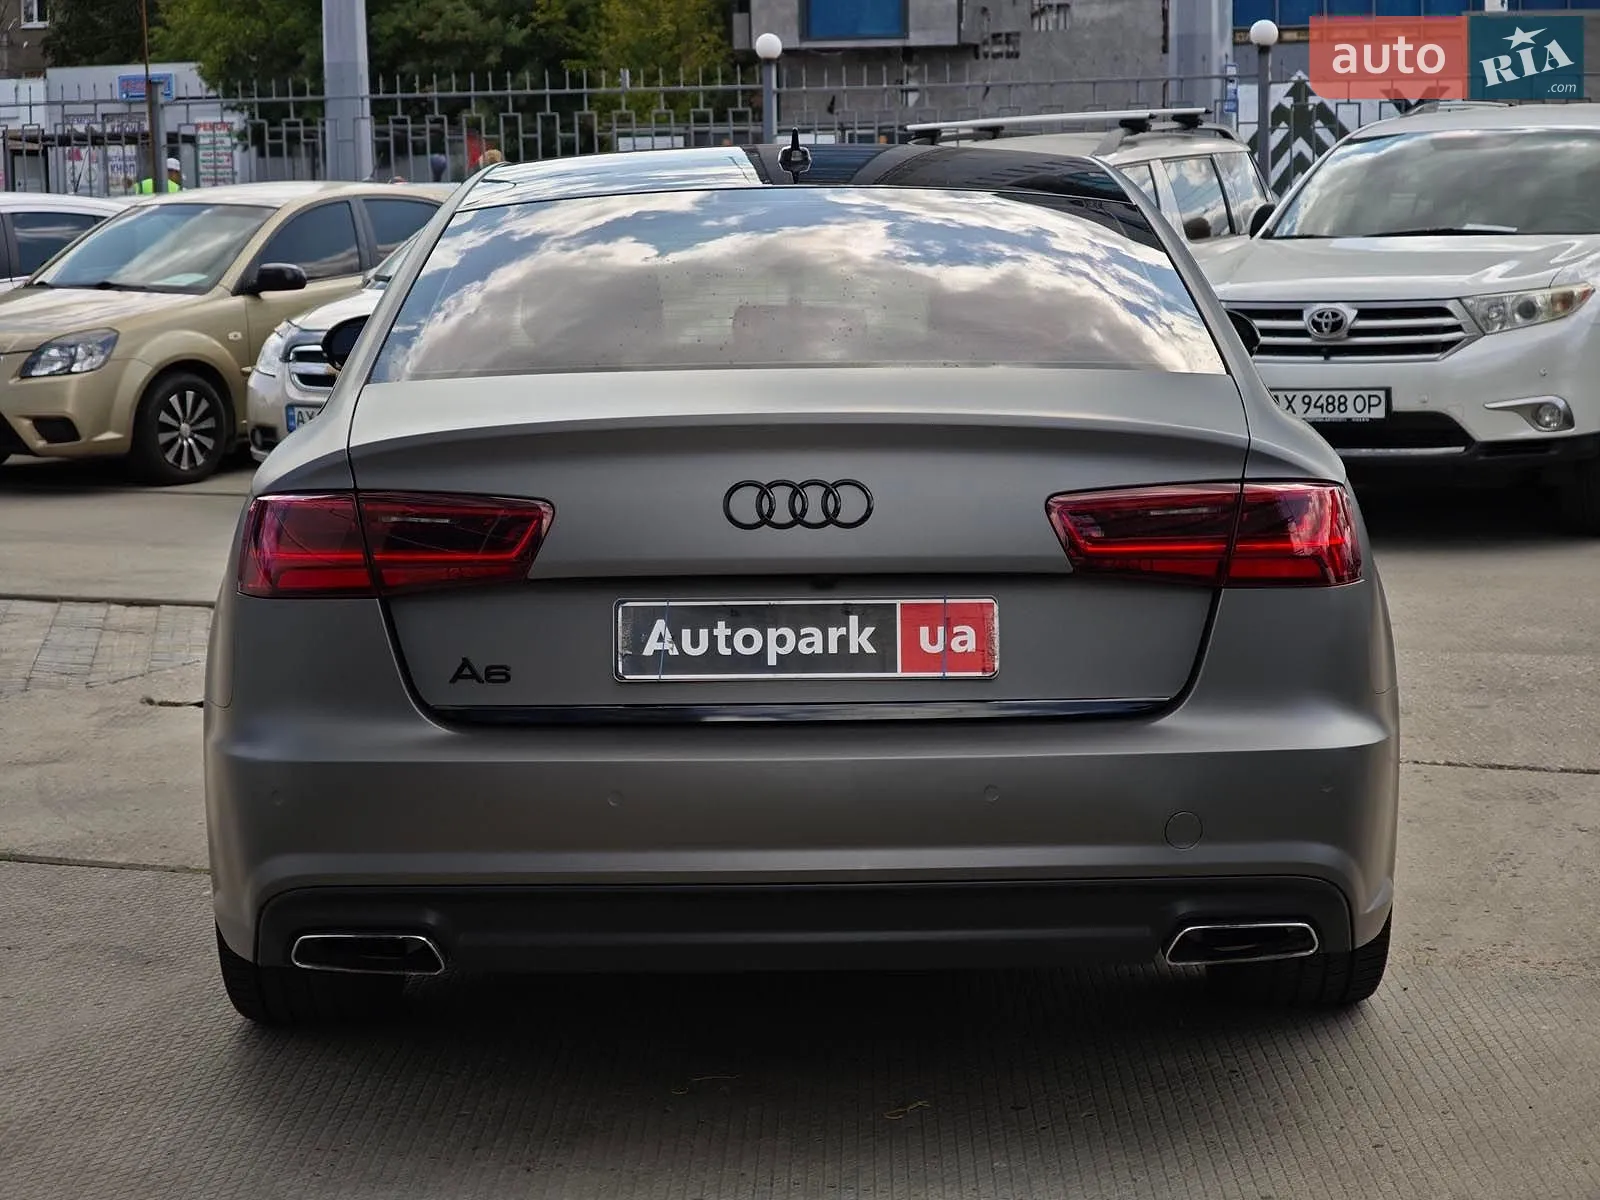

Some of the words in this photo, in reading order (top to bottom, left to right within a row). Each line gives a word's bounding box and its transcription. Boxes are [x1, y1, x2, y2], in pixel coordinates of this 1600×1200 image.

[1302, 394, 1348, 414] 9488
[1353, 394, 1382, 414] OP
[642, 615, 877, 666] Autopark
[918, 625, 977, 653] ua
[448, 656, 512, 684] A6
